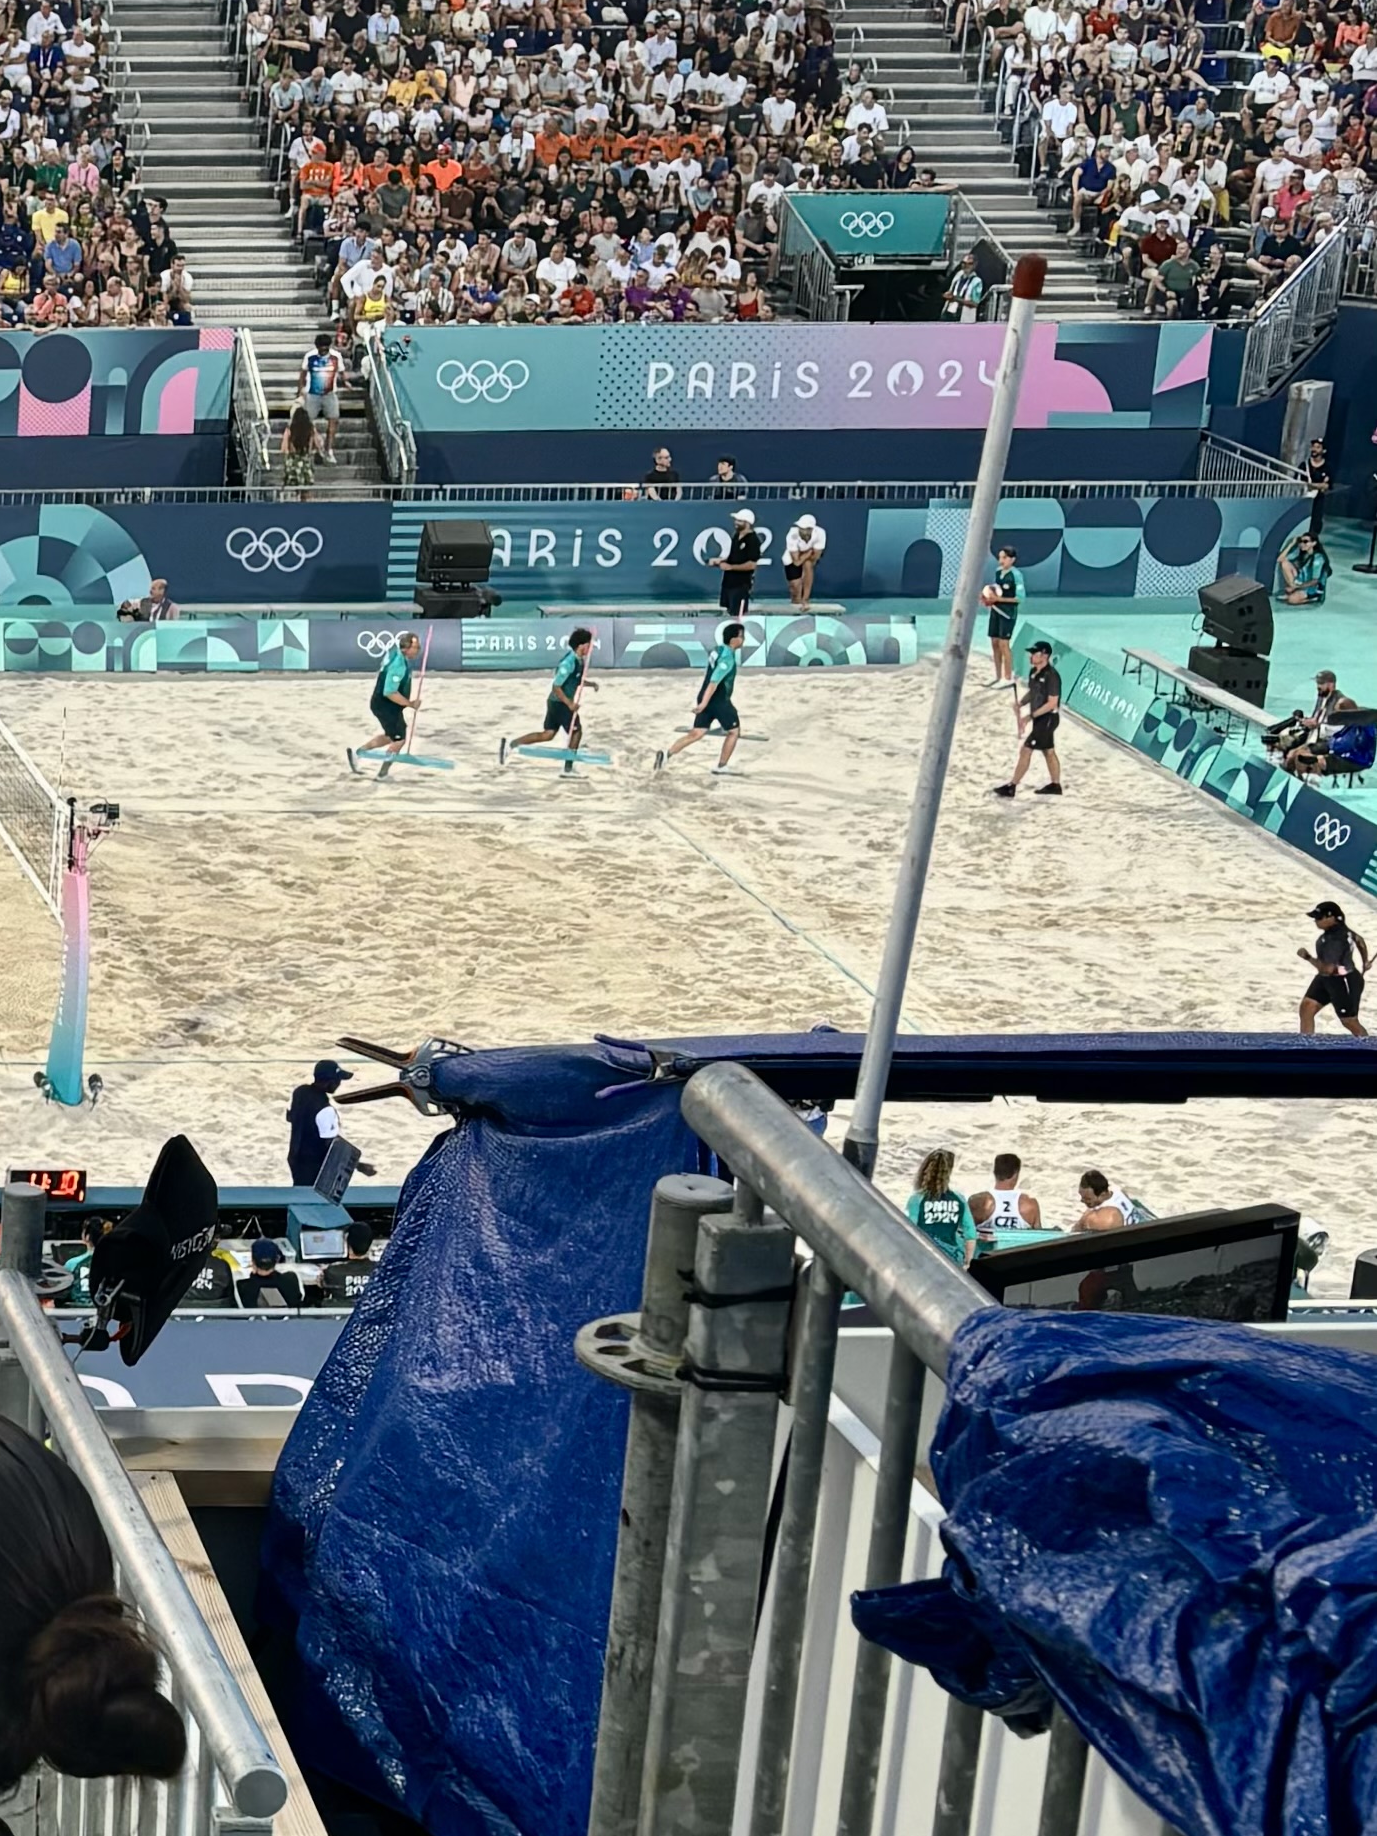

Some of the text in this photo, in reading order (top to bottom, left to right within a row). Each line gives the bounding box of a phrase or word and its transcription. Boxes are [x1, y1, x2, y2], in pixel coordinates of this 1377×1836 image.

[489, 527, 623, 568] ARIS
[1003, 1201, 1010, 1212] 2
[995, 1216, 1018, 1228] CZE
